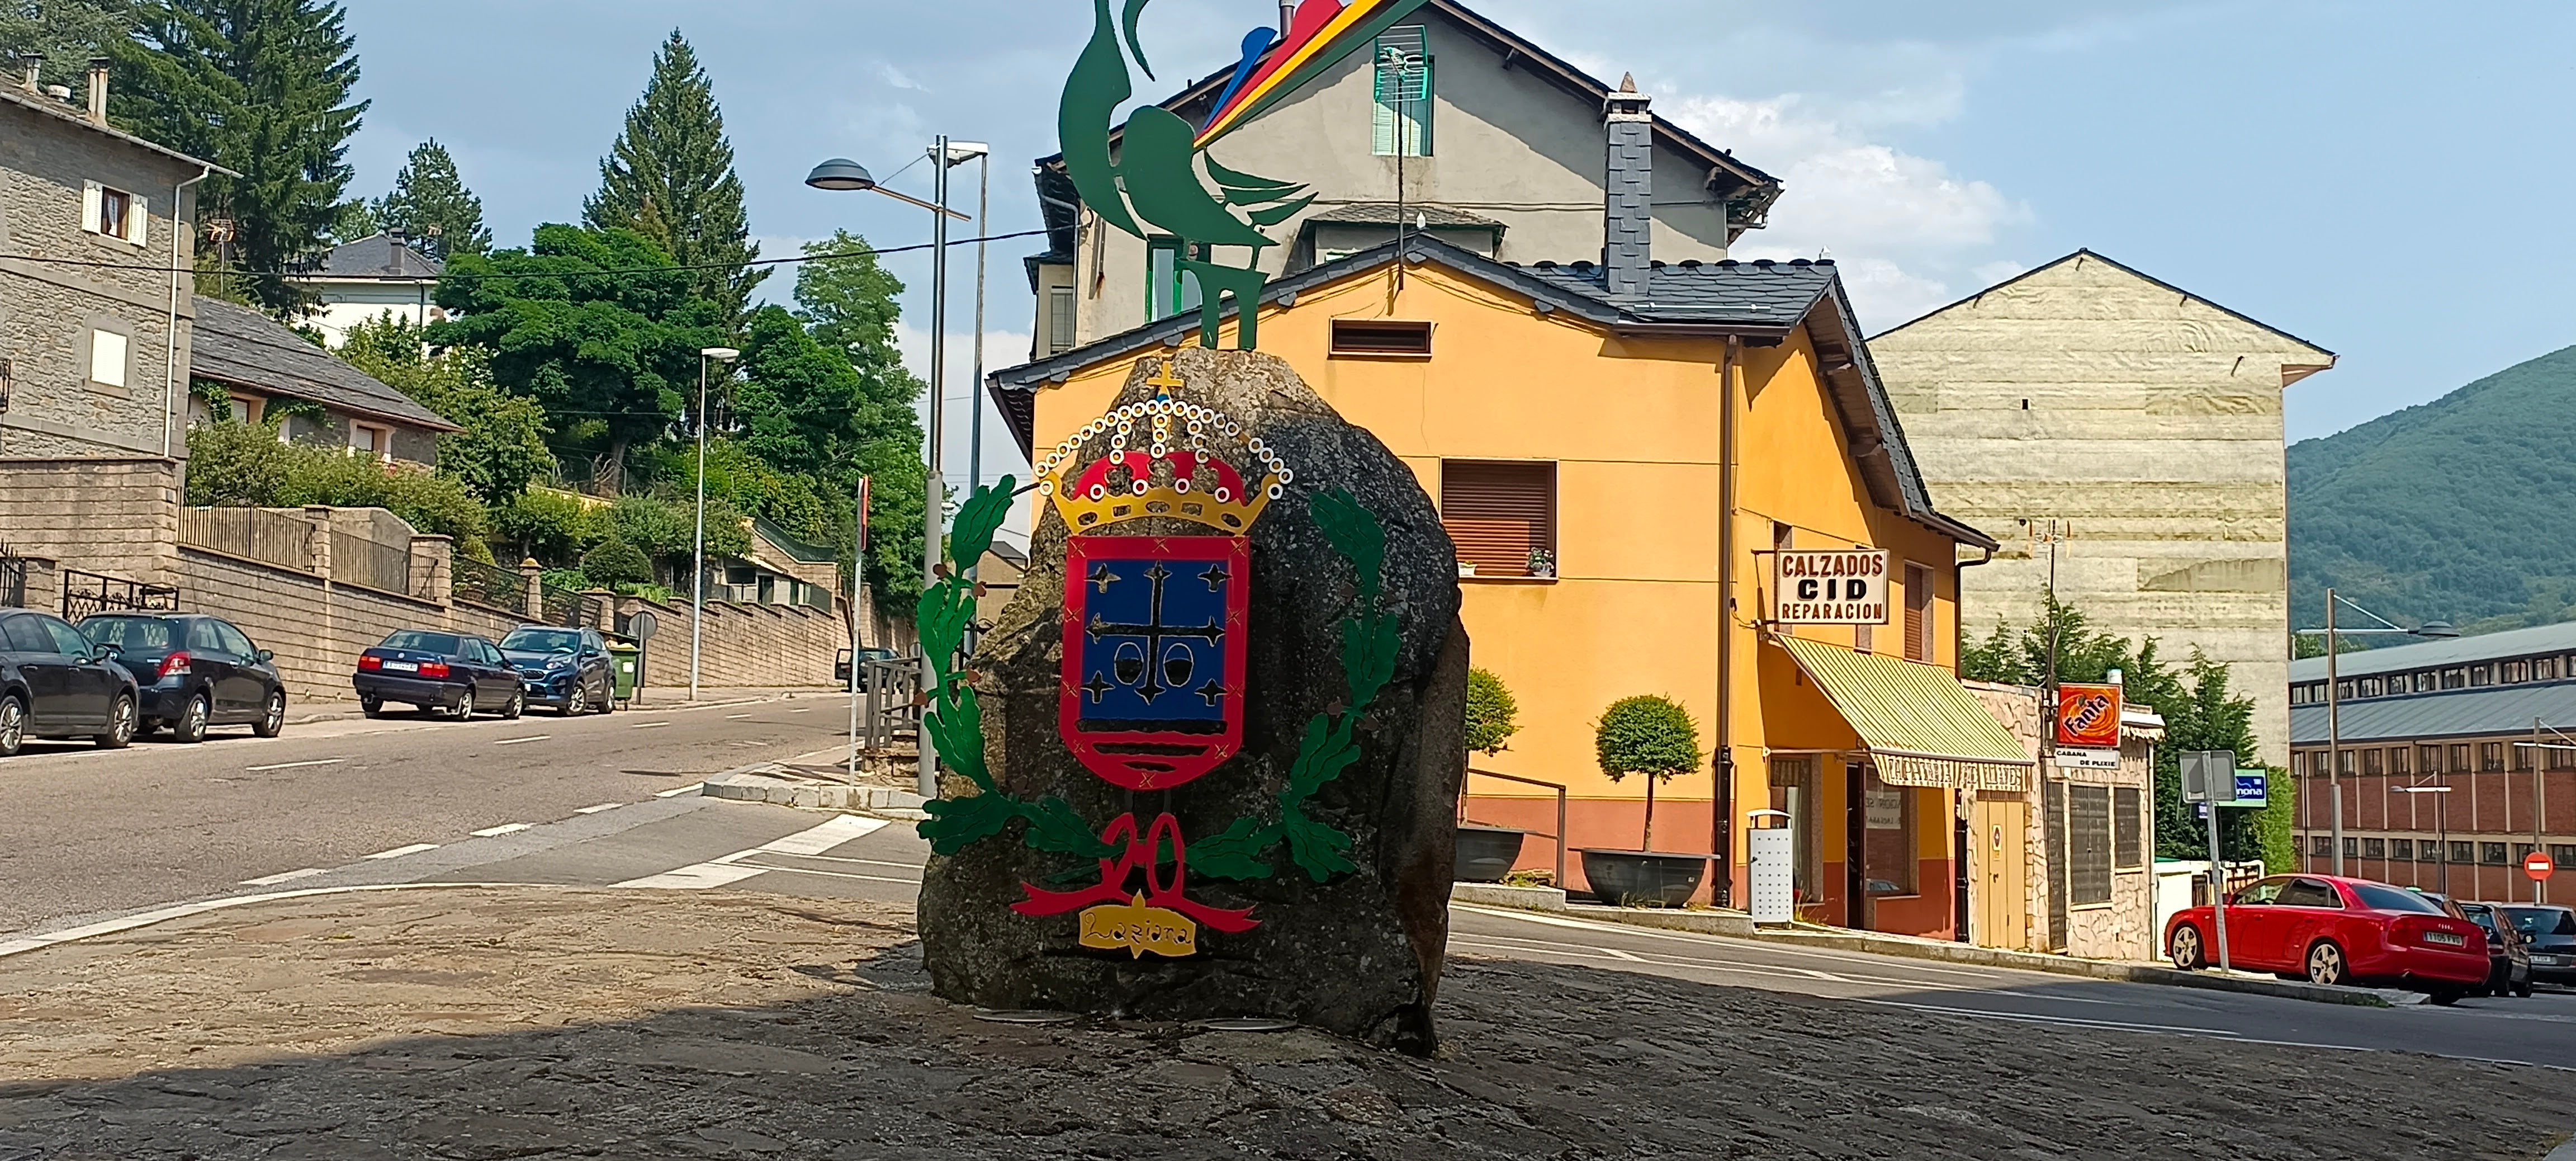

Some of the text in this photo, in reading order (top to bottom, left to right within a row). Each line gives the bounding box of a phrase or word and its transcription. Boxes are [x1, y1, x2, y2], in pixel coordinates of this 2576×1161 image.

[1782, 554, 1882, 577] CALZADOS
[1797, 579, 1867, 601] CID
[1782, 603, 1882, 619] REPARACION
[2063, 695, 2110, 736] Fanta
[2428, 933, 2446, 942] 1105
